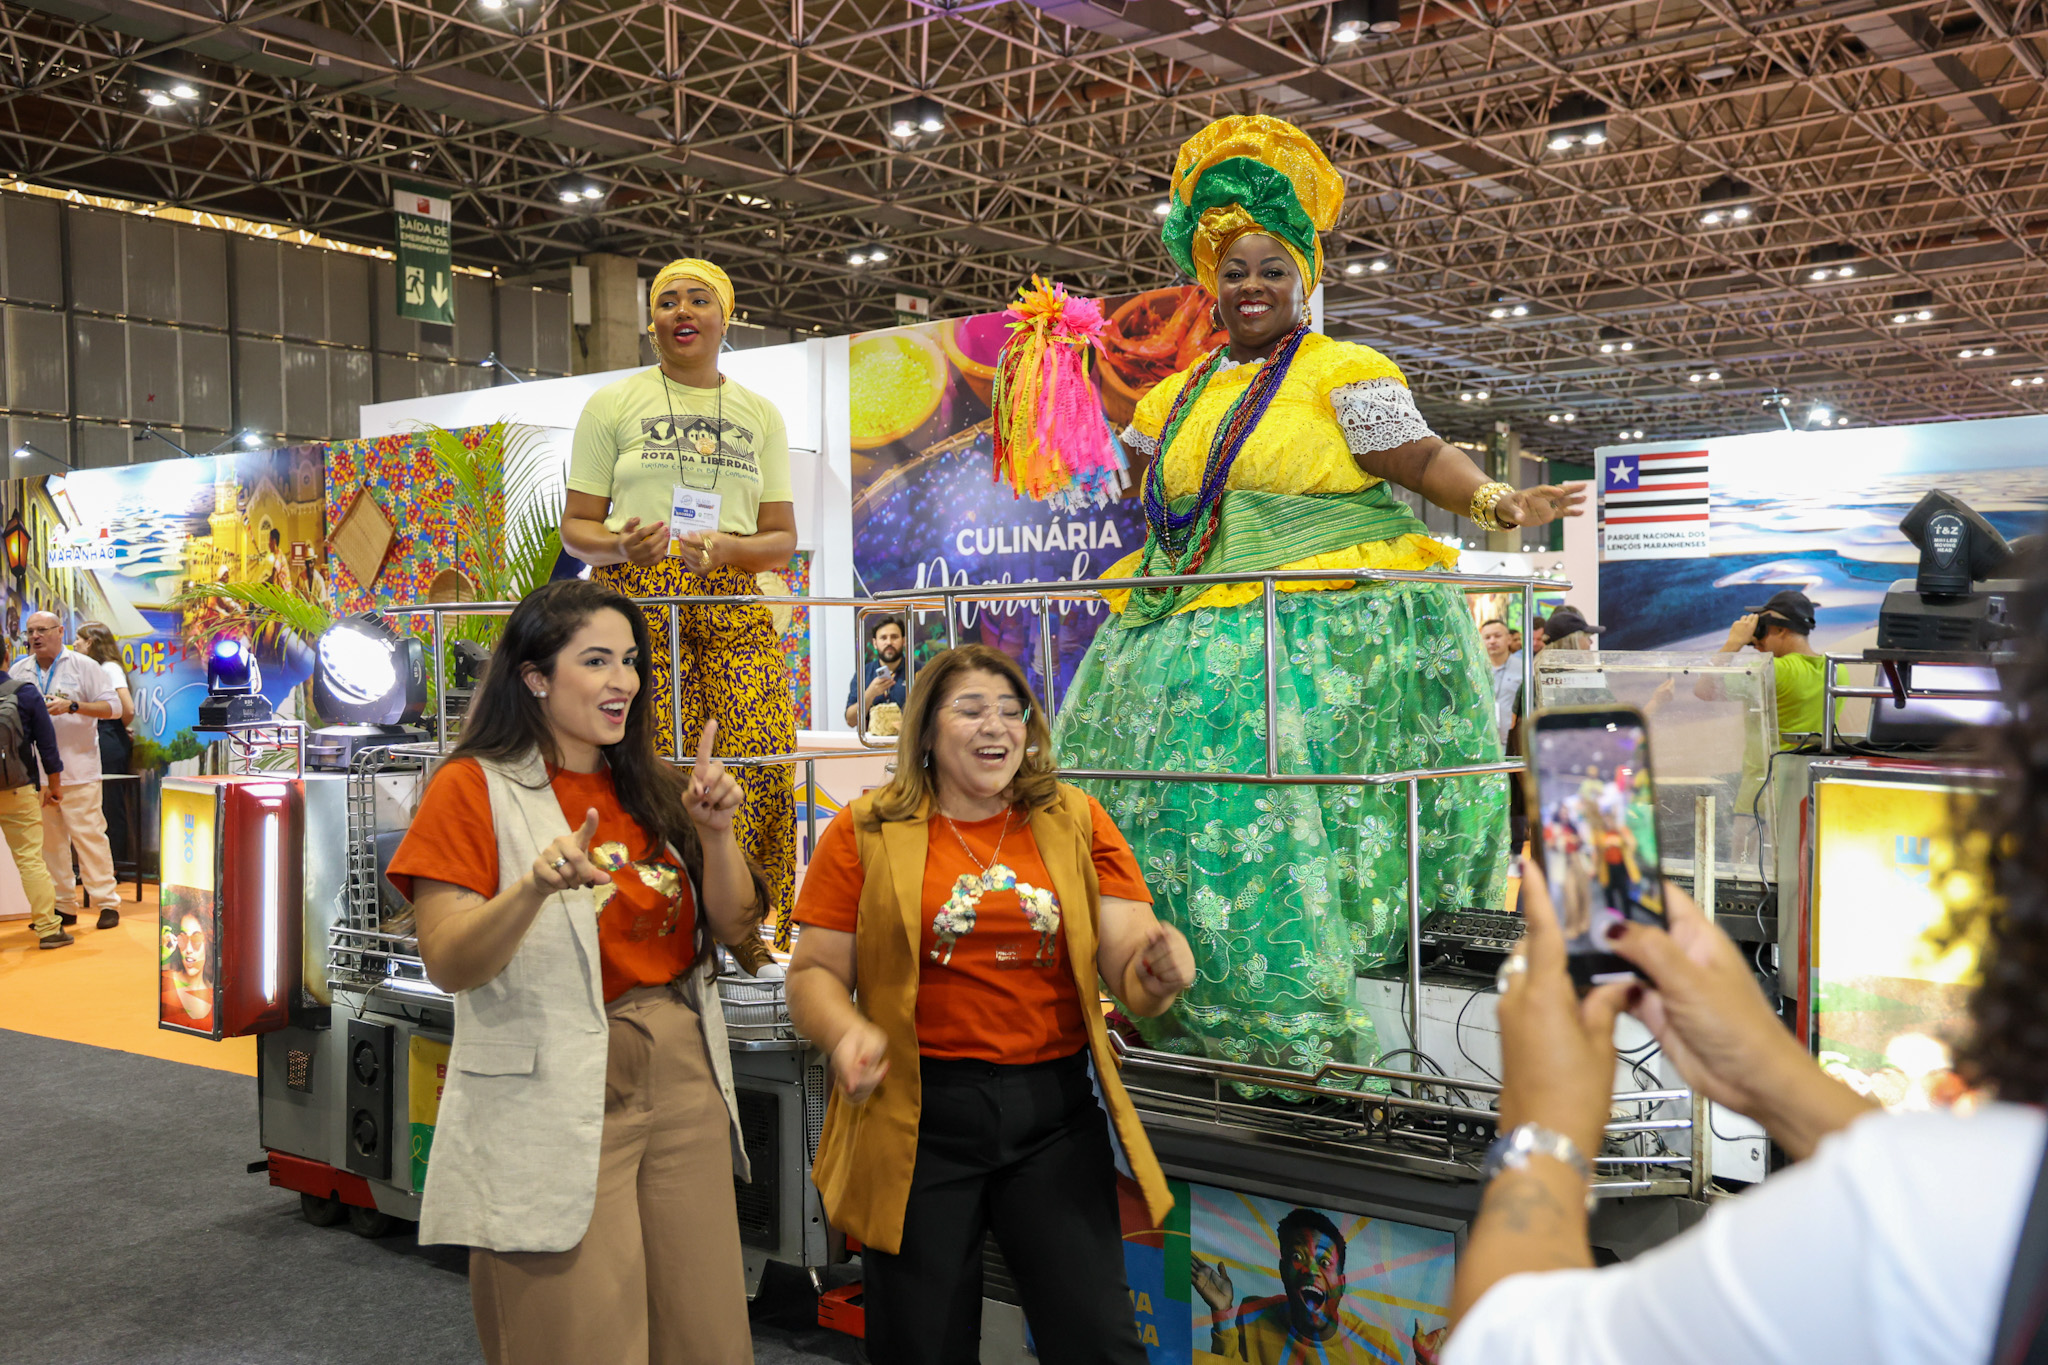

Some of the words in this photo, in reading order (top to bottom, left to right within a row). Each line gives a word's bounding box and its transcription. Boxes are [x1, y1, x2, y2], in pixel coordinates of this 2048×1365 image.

[399, 218, 432, 234] SAÍDA
[433, 225, 448, 238] DE
[641, 452, 675, 460] ROTA
[681, 454, 696, 463] DA
[700, 456, 759, 475] LIBERDADE
[956, 516, 1122, 556] CULINÁRIA
[1606, 533, 1640, 541] PARQUE
[1643, 531, 1685, 539] NACIONAL
[1688, 530, 1706, 538] DOS
[1606, 542, 1641, 551] LENÇÓIS
[1643, 541, 1706, 549] MARANHENSES
[140, 643, 166, 673] DE
[184, 813, 195, 864] OXE
